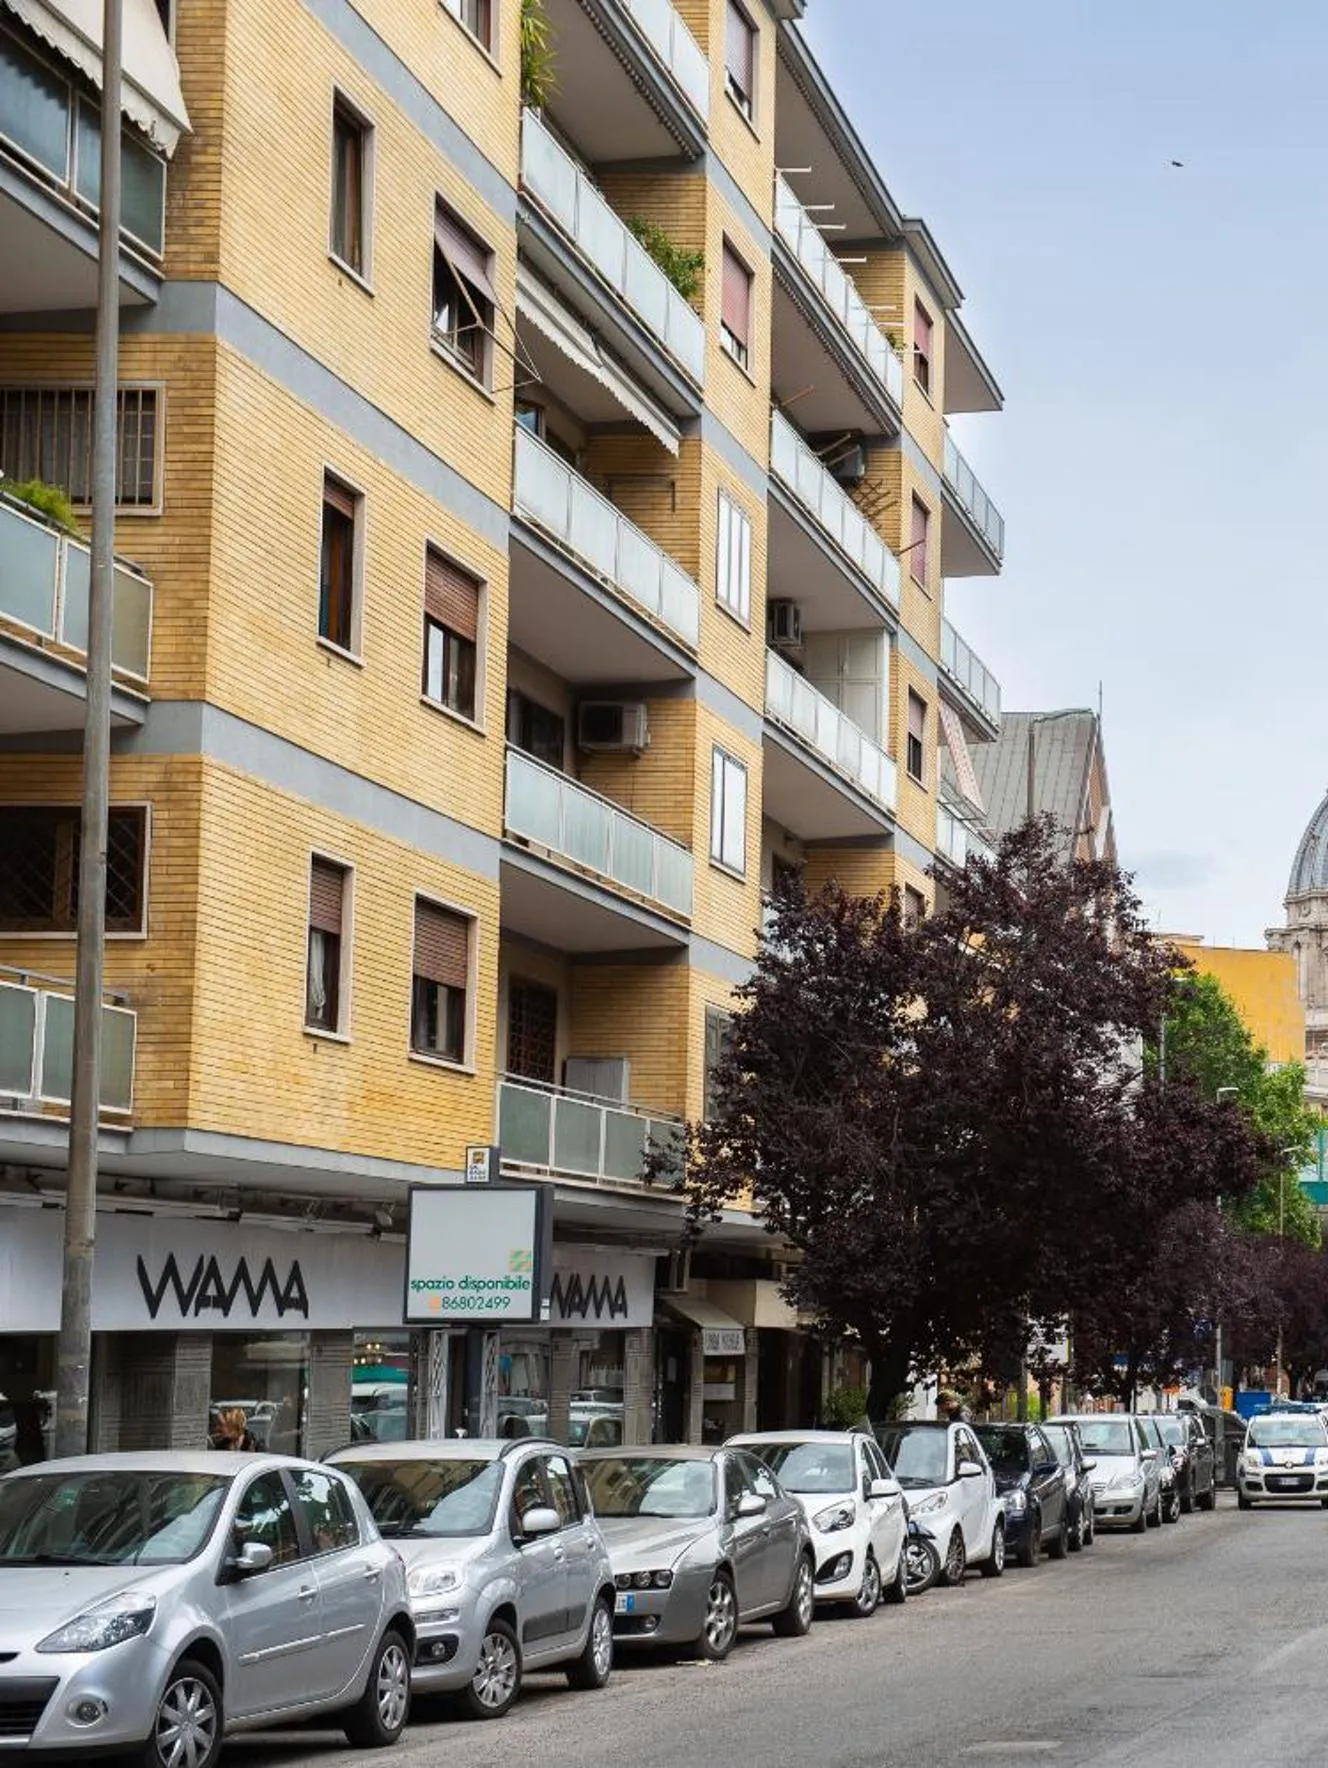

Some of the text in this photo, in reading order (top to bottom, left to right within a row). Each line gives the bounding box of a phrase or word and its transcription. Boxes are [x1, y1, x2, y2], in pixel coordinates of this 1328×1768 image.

[137, 1252, 309, 1319] WAMA
[410, 1276, 531, 1292] spazio disponibile
[441, 1296, 510, 1311] 86802499
